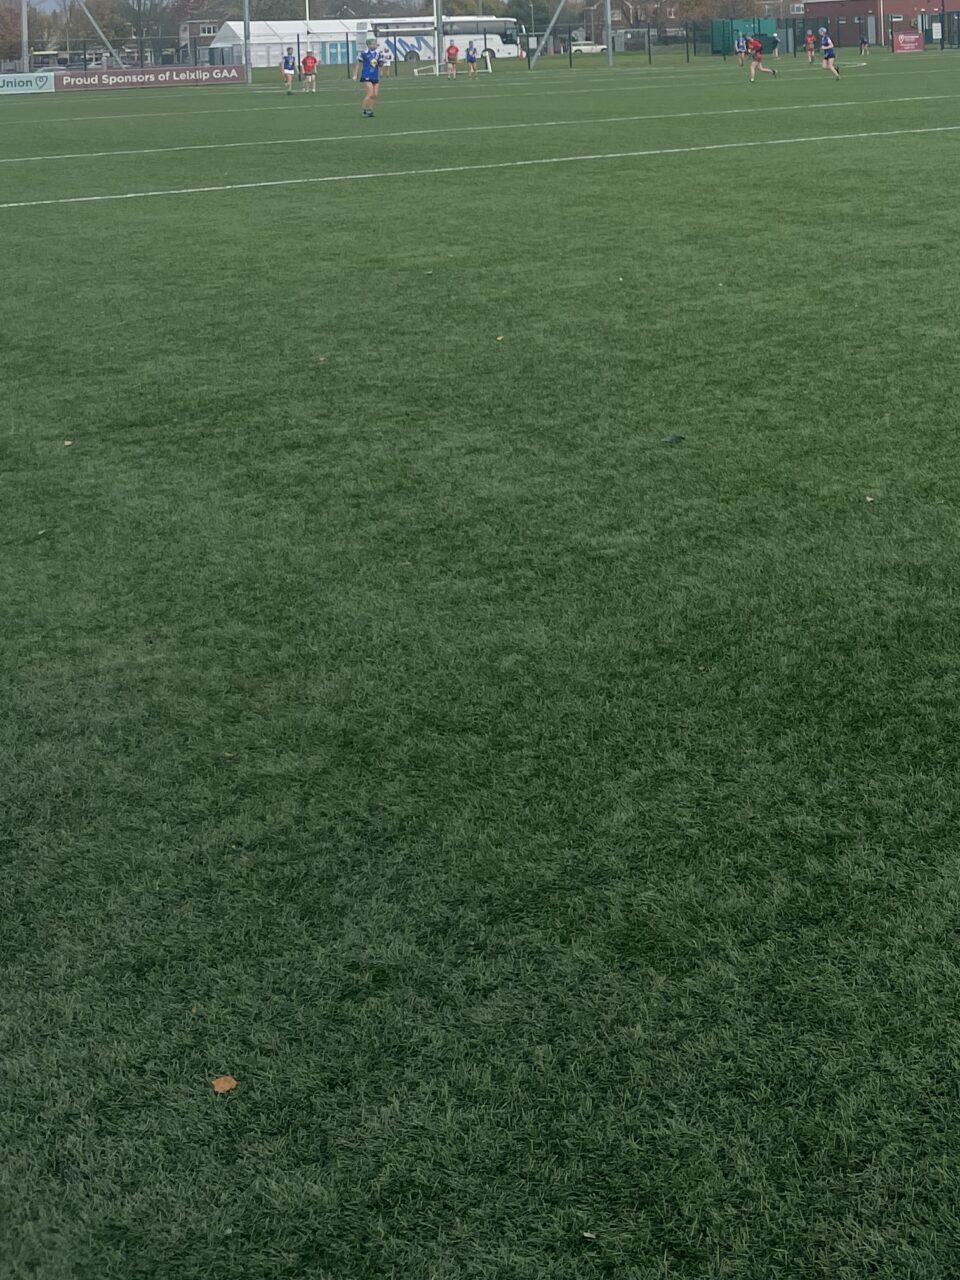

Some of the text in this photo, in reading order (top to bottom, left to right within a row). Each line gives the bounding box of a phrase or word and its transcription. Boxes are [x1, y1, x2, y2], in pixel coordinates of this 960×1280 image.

[63, 68, 238, 86] Proud Sponsors of Leixlip GAA
